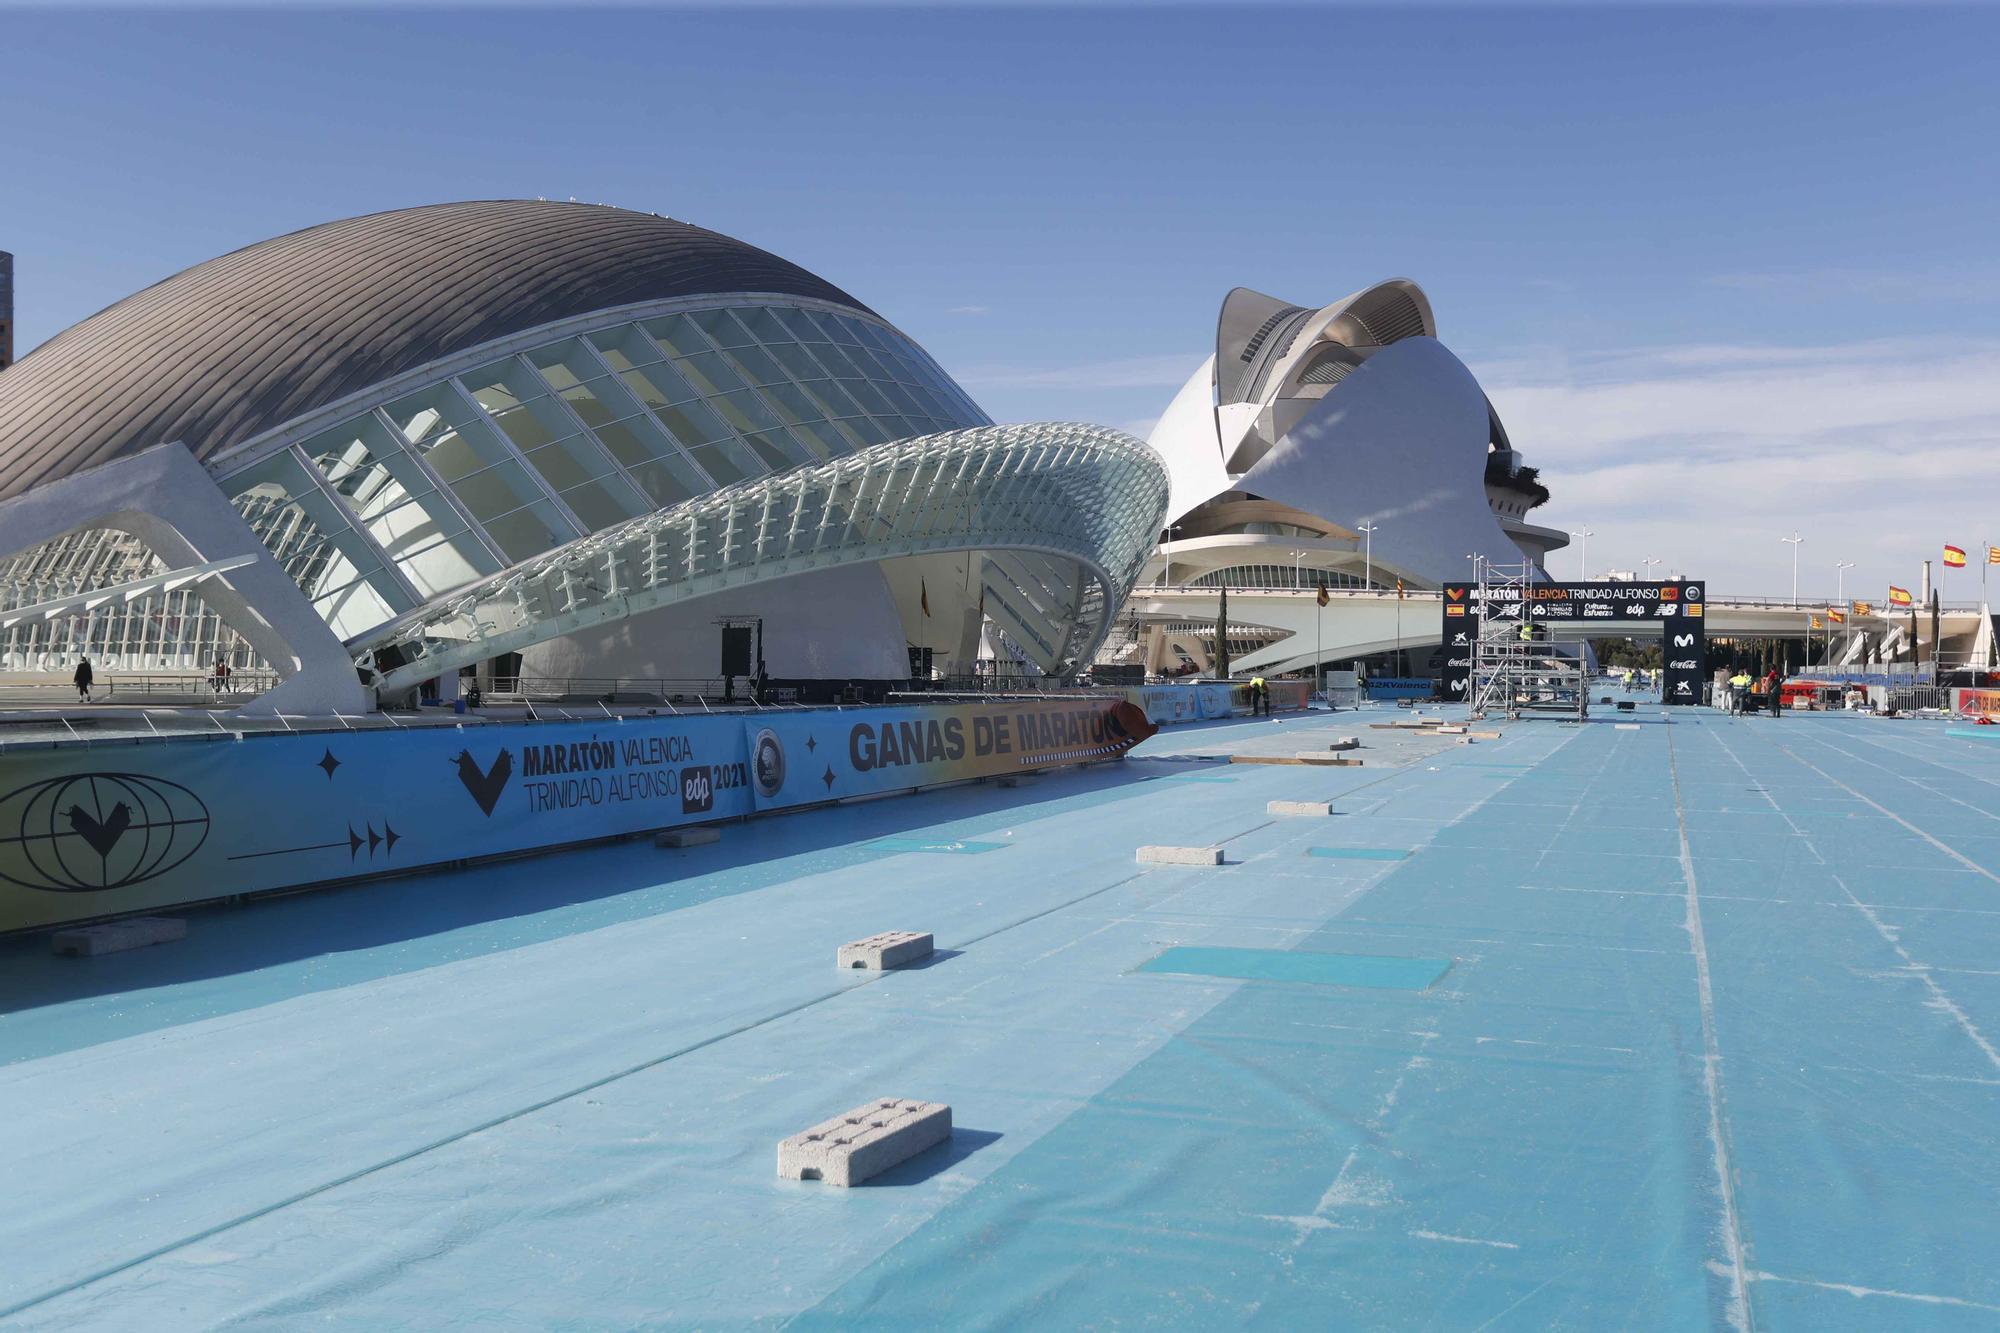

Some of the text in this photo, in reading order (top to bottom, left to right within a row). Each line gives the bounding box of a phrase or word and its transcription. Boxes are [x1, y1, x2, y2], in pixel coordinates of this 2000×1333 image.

[1521, 589, 1568, 599] VALENCIA
[1567, 589, 1613, 599] TRINIDAD
[1613, 589, 1659, 599] ALFONSO
[1626, 603, 1646, 616] edp
[523, 734, 694, 777] MARATÓN VALENCIA
[850, 702, 1128, 773] GANAS DE MARATÓN
[523, 776, 604, 813] TRINIDAD
[608, 769, 678, 804] ALFONSO
[685, 771, 710, 807] edp
[713, 762, 748, 790] 2021
